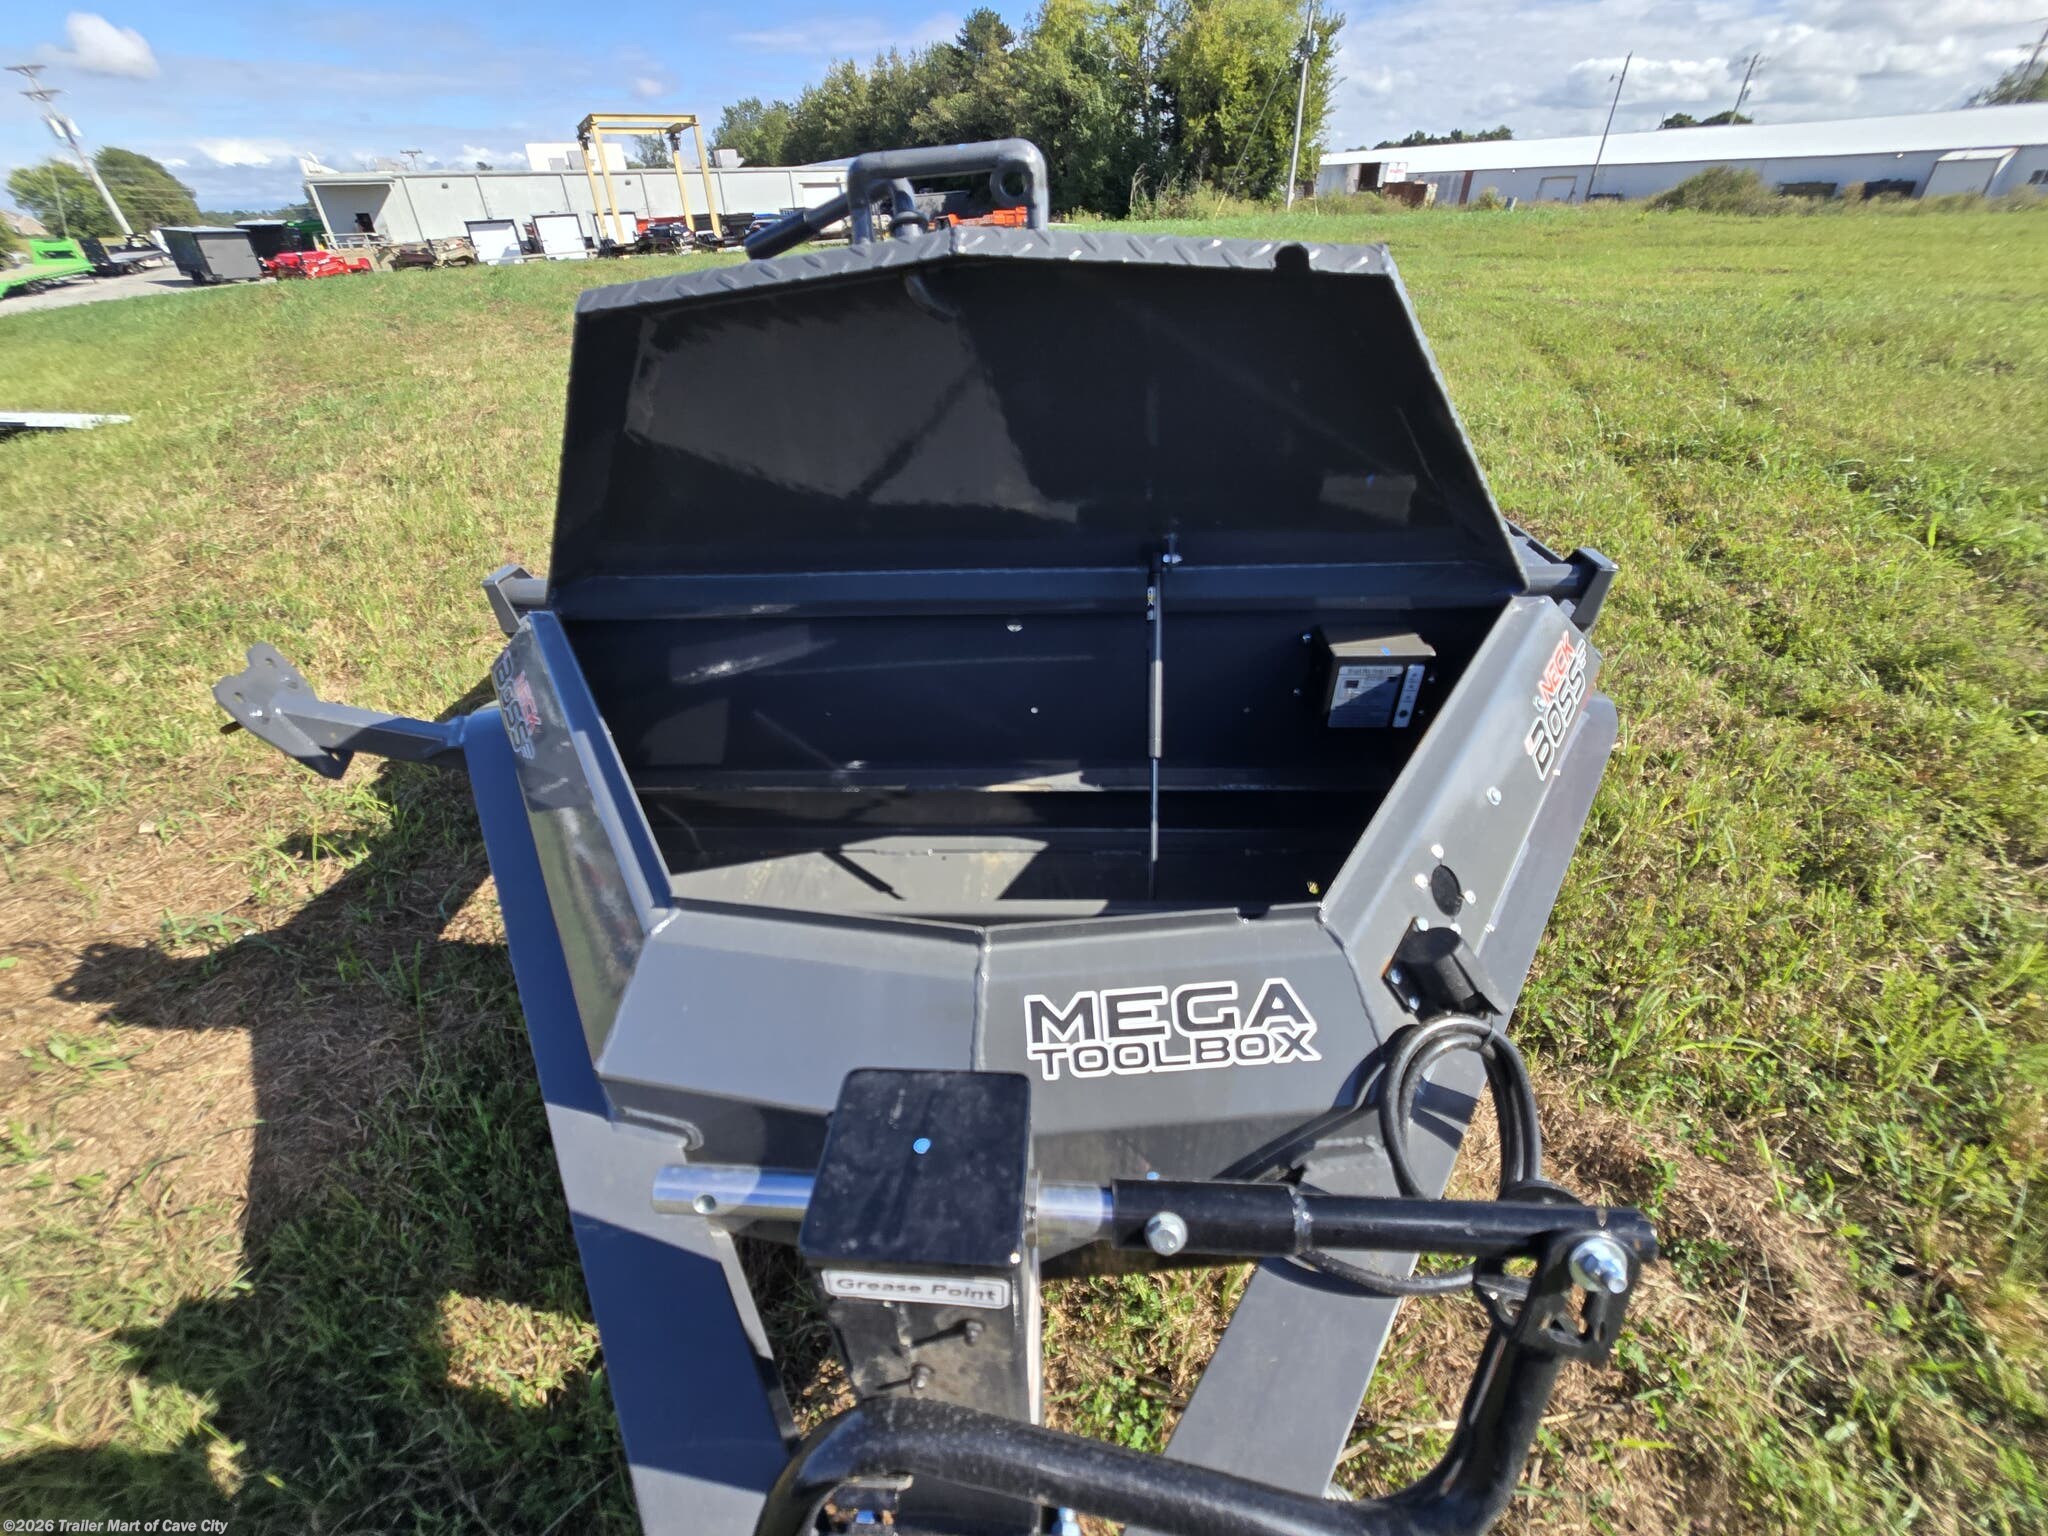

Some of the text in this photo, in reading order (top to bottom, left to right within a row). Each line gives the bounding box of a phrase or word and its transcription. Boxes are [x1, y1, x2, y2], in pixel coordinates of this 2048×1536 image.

[1537, 630, 1575, 704] NECK
[493, 655, 531, 753] BOSS
[1529, 650, 1586, 782] BOSS
[1025, 978, 1316, 1045] MEGA
[1028, 1028, 1321, 1080] TOOLBOX
[836, 1278, 997, 1301] Grease Point
